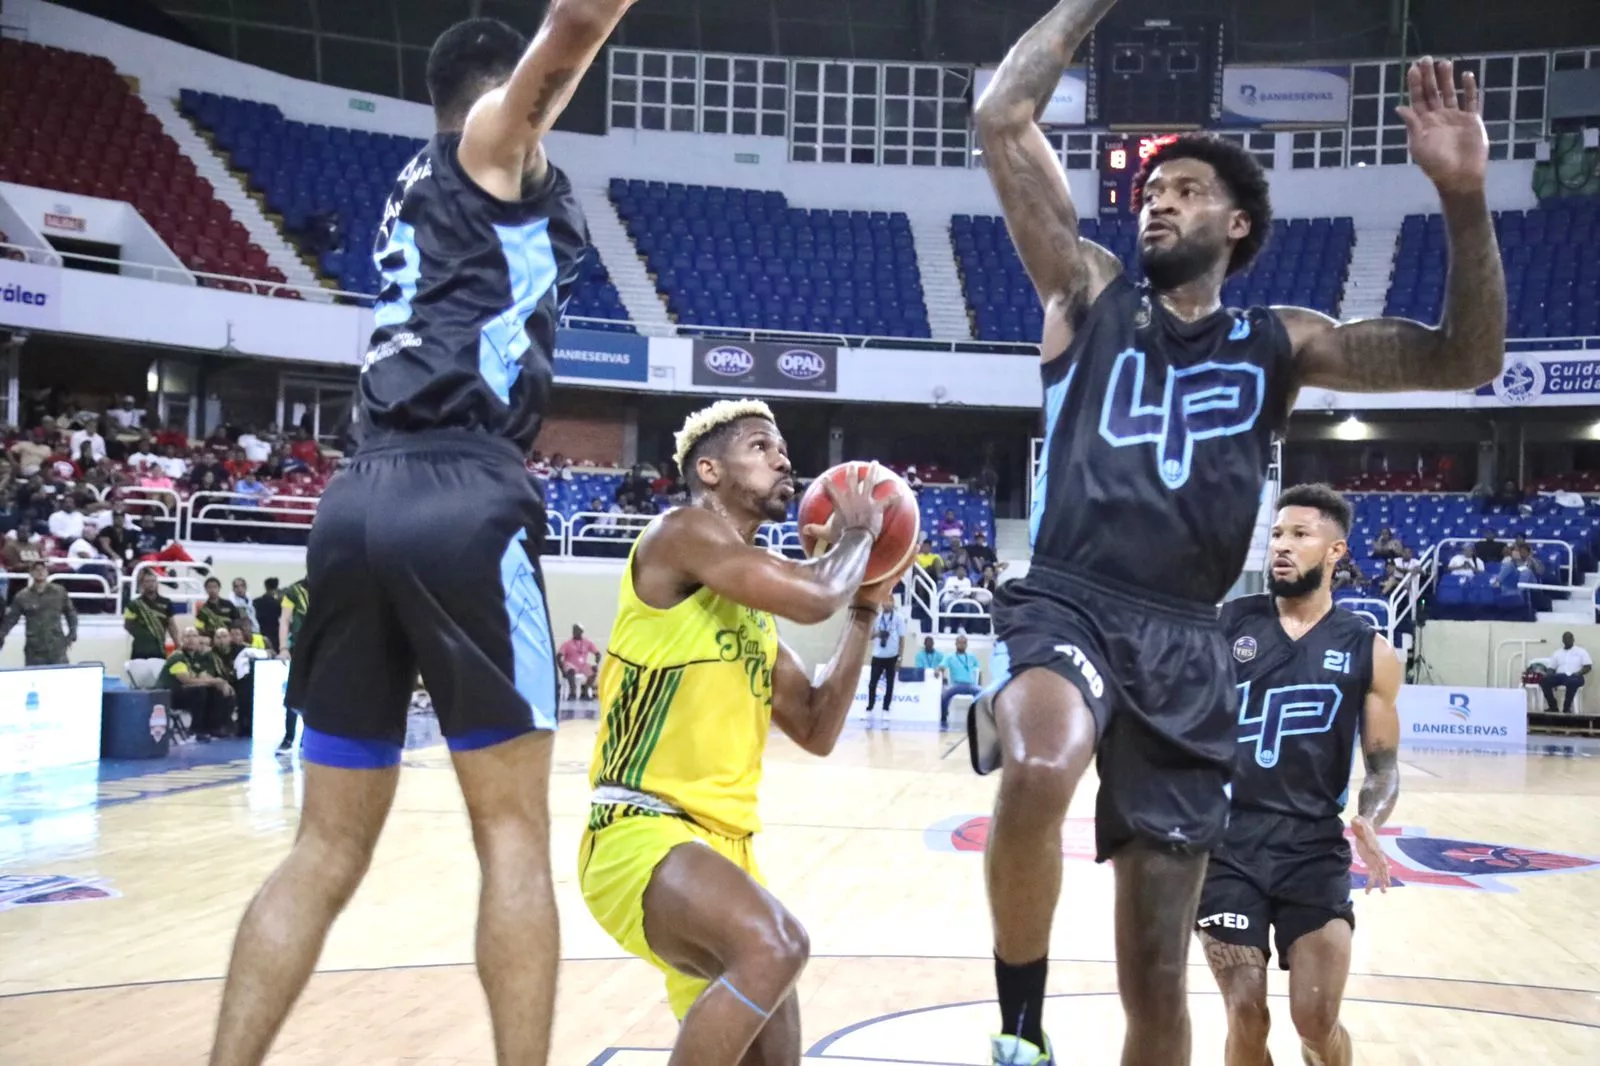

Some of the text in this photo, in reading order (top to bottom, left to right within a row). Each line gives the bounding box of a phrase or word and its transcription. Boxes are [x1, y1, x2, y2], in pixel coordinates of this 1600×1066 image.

[709, 351, 750, 369] OPAL
[780, 355, 823, 371] OPAL
[1323, 649, 1351, 674] 21
[1412, 723, 1508, 736] BANRESERVAS
